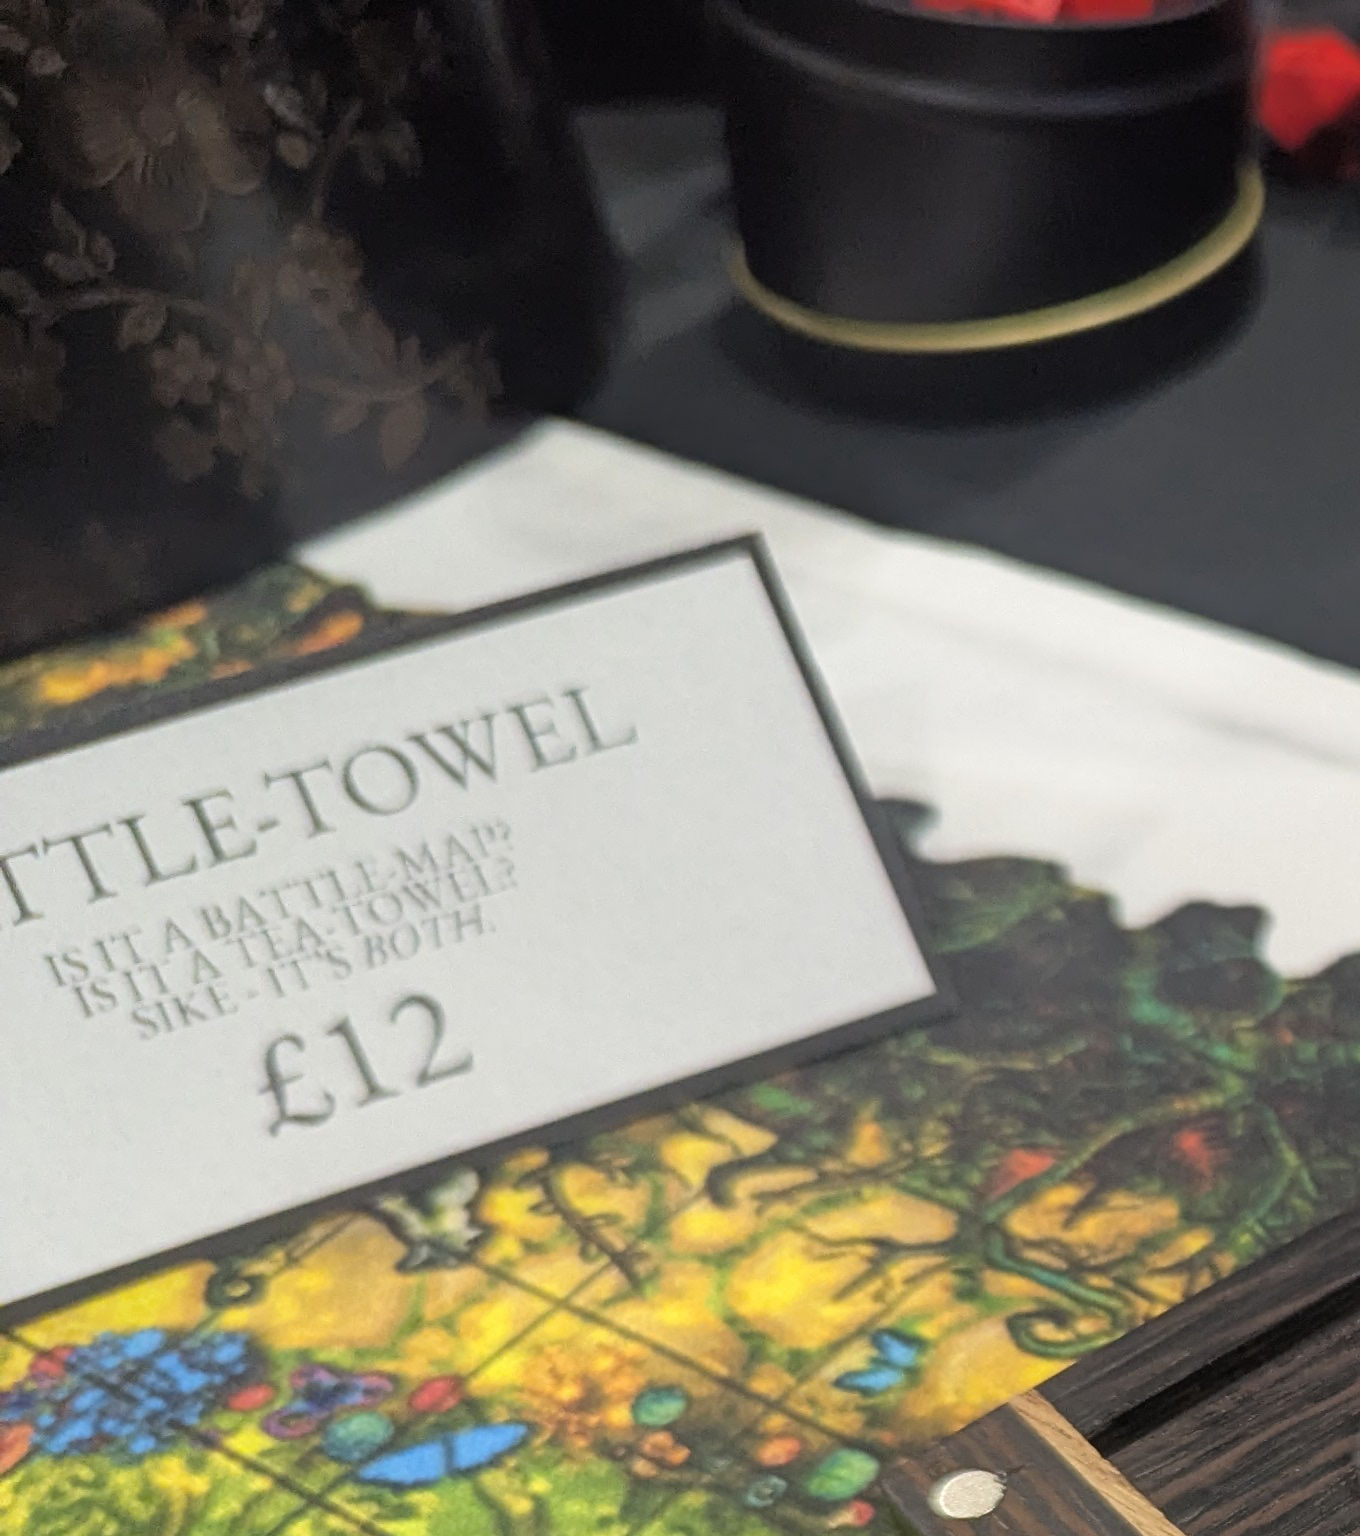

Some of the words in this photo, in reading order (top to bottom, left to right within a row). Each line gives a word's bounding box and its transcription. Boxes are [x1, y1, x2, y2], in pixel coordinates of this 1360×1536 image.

[43, 946, 89, 986] IS
[94, 928, 142, 971] IT
[164, 917, 195, 954] A
[199, 819, 514, 939] BATTLE-MAP?
[74, 981, 118, 1018] IS
[124, 961, 169, 1002] IT
[191, 948, 222, 984] A
[225, 856, 518, 968] TEA-TOWEL?
[131, 986, 238, 1040] SIKE
[267, 945, 352, 998] IT'S
[257, 993, 475, 1138] £12
